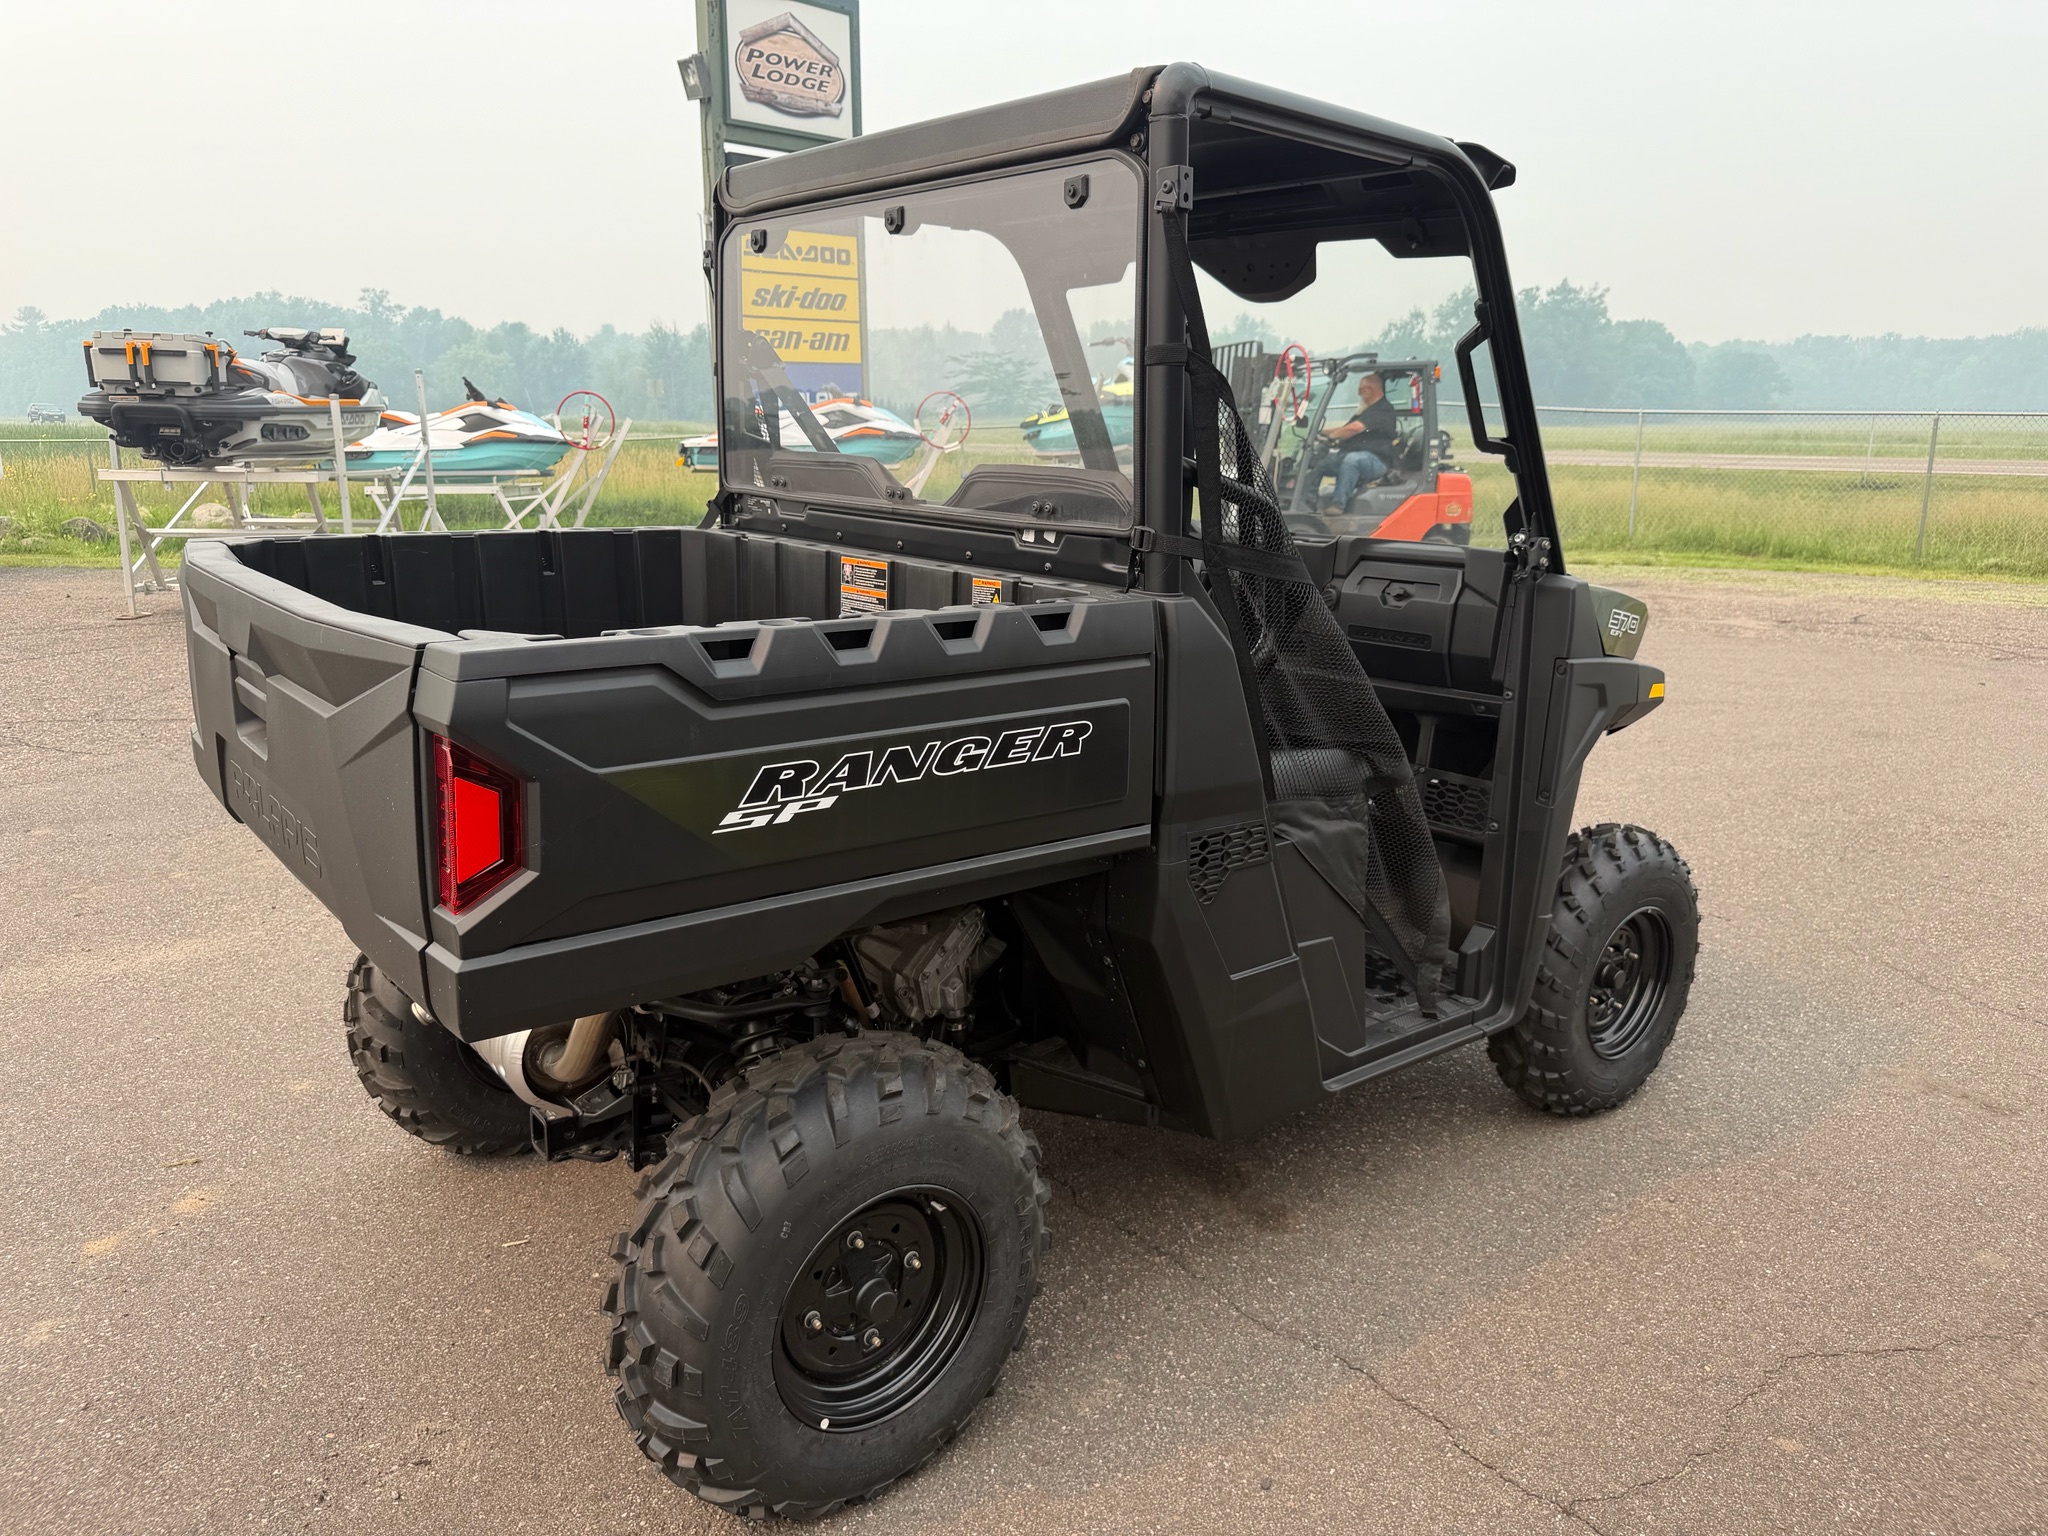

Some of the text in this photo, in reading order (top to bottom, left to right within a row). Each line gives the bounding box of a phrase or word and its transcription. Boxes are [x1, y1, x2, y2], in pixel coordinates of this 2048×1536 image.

[745, 47, 833, 78] POWER
[751, 63, 831, 93] LODGE
[751, 284, 847, 311] ski-doo
[1608, 608, 1640, 635] 570
[738, 720, 1093, 808] RANGER
[230, 759, 322, 880] POLARIS
[711, 795, 839, 834] SP
